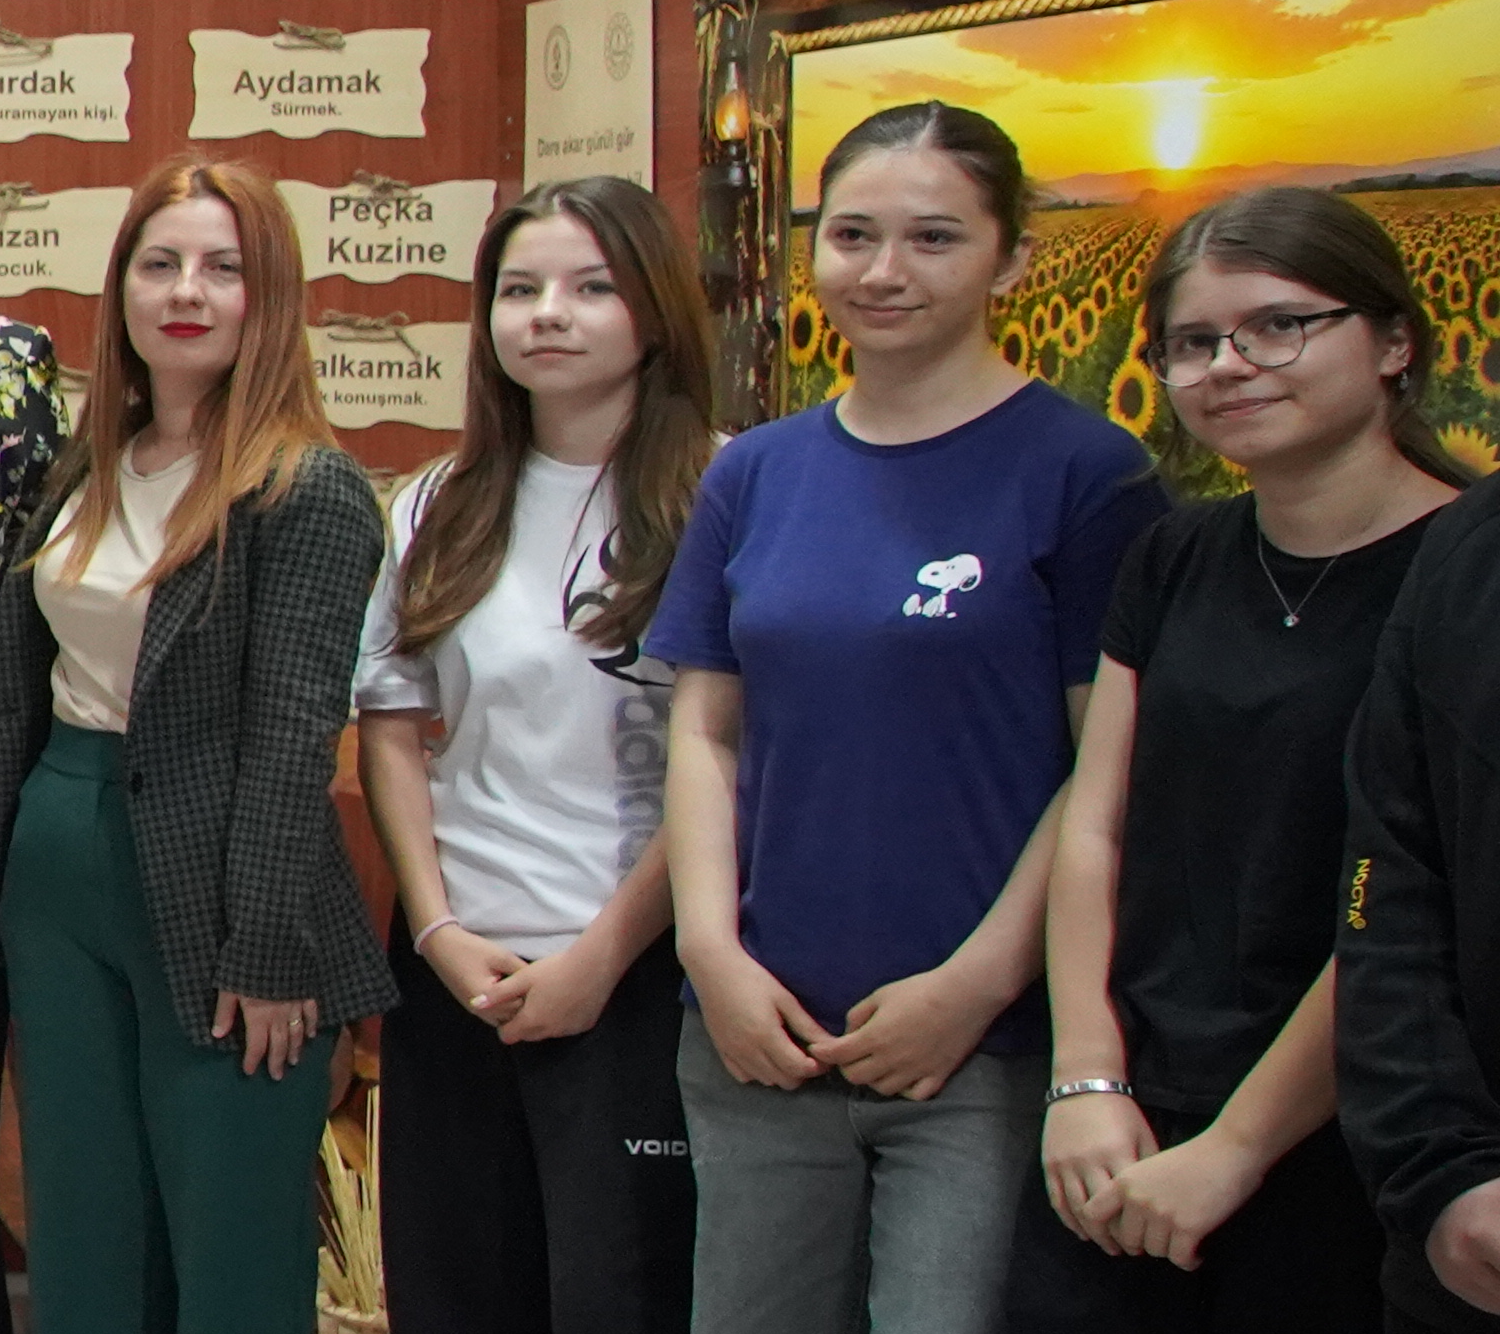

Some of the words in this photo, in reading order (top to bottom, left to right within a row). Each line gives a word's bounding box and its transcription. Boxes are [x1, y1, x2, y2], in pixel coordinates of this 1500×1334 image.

[232, 68, 382, 101] Aydamak
[270, 100, 343, 118] Sürmek.
[328, 194, 434, 230] Peçka
[327, 235, 448, 265] Kuzine
[333, 388, 428, 408] konuşmak.
